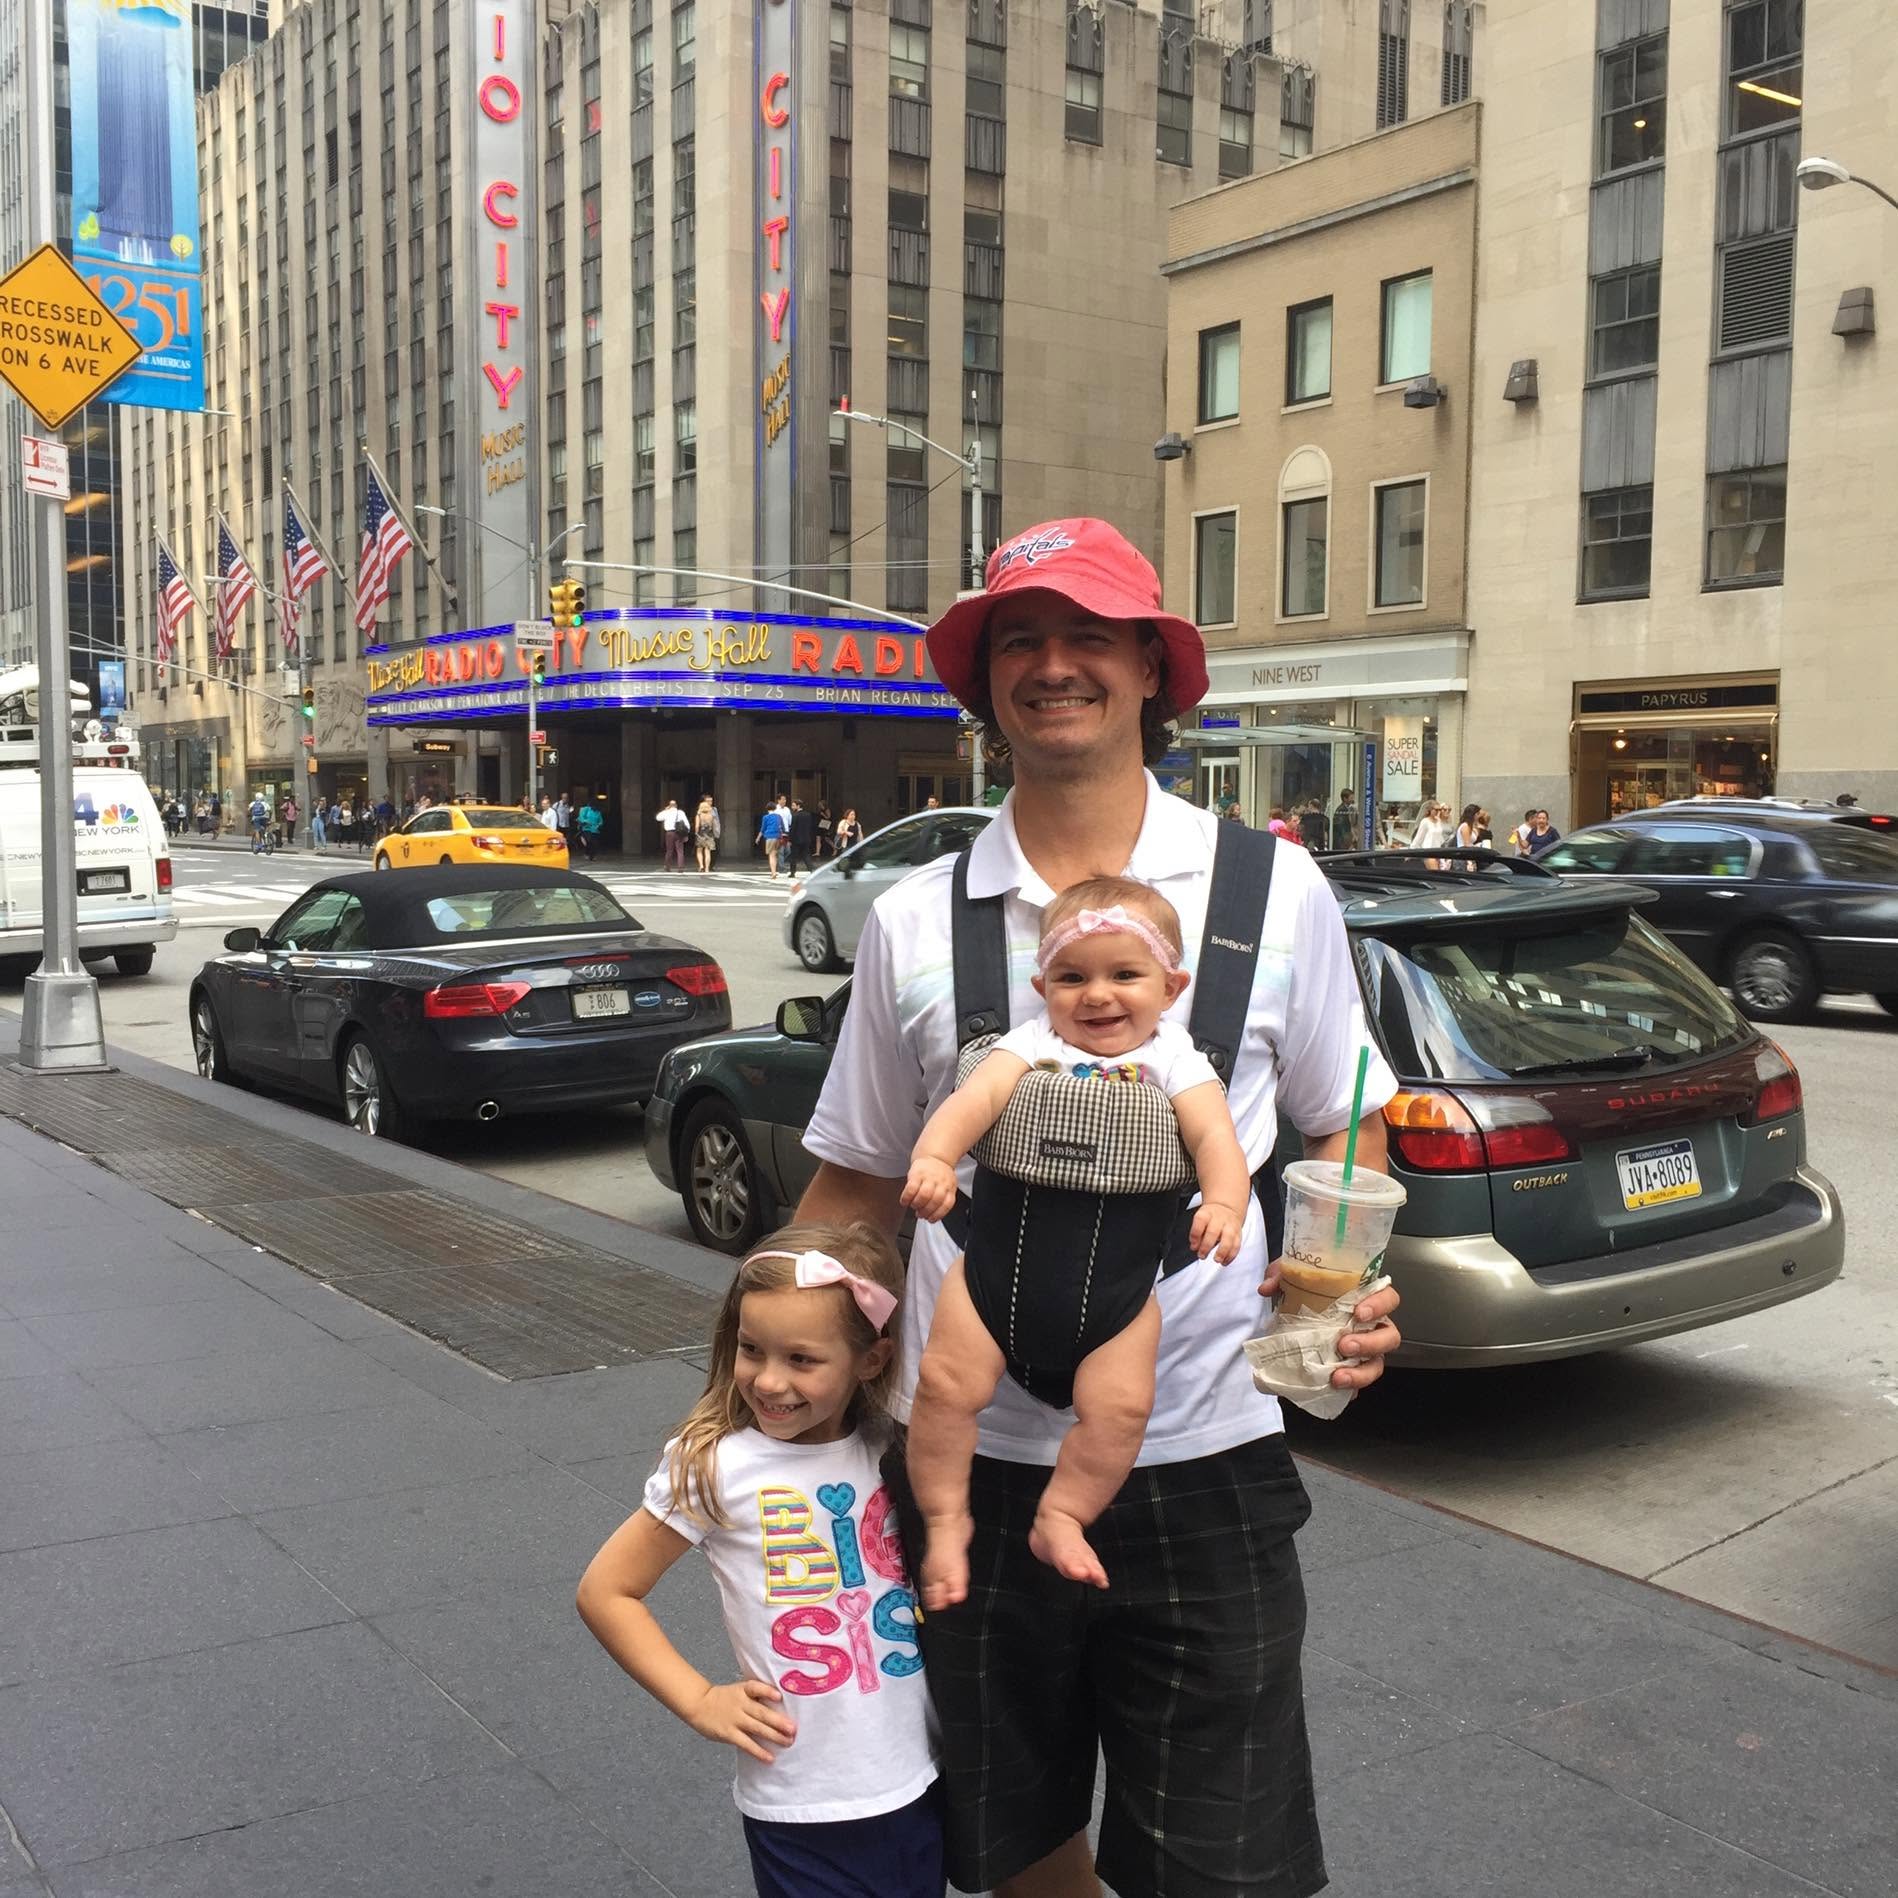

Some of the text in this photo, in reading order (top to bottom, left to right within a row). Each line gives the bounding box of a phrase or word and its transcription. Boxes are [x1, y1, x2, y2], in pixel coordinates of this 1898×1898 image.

[761, 72, 790, 343] CITY
[482, 180, 524, 410] CITY
[0, 295, 103, 327] RECESSED
[1, 321, 113, 354] ROSSWALK
[1, 347, 101, 377] ON 6 AVE
[425, 639, 504, 686] RADIO
[515, 626, 590, 674] CTY
[598, 623, 925, 678] Music Hall RADI
[1252, 664, 1322, 686] NINE WEST
[722, 682, 753, 698] SEP
[764, 684, 785, 699] 25
[815, 687, 862, 703] BRIAN
[871, 689, 922, 706] REGAN
[1641, 691, 1708, 707] PAPYRUS
[1387, 737, 1419, 750] SUPER
[1387, 760, 1419, 776] SALE
[102, 825, 141, 835] YORK
[1607, 1082, 1721, 1111] SUBARU
[1511, 1171, 1568, 1192] OUTBACK
